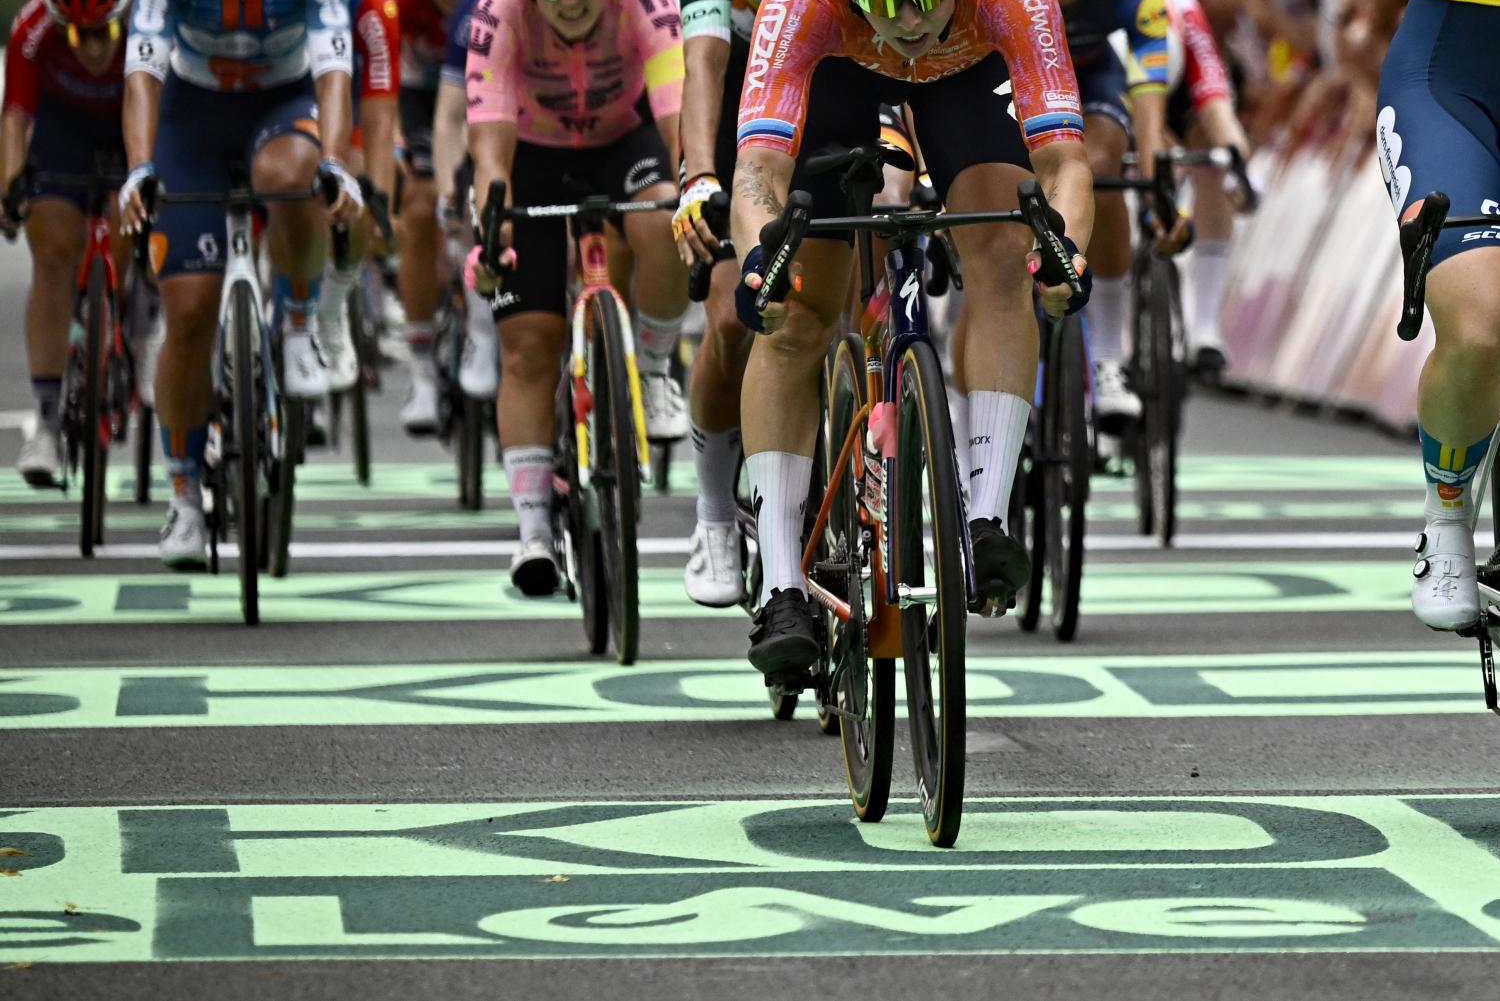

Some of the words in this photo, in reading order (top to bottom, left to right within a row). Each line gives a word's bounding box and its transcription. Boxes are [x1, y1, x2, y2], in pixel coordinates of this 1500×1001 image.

[772, 13, 801, 70] INSURANCE
[760, 244, 791, 297] SRAM
[1044, 229, 1079, 281] SRAM
